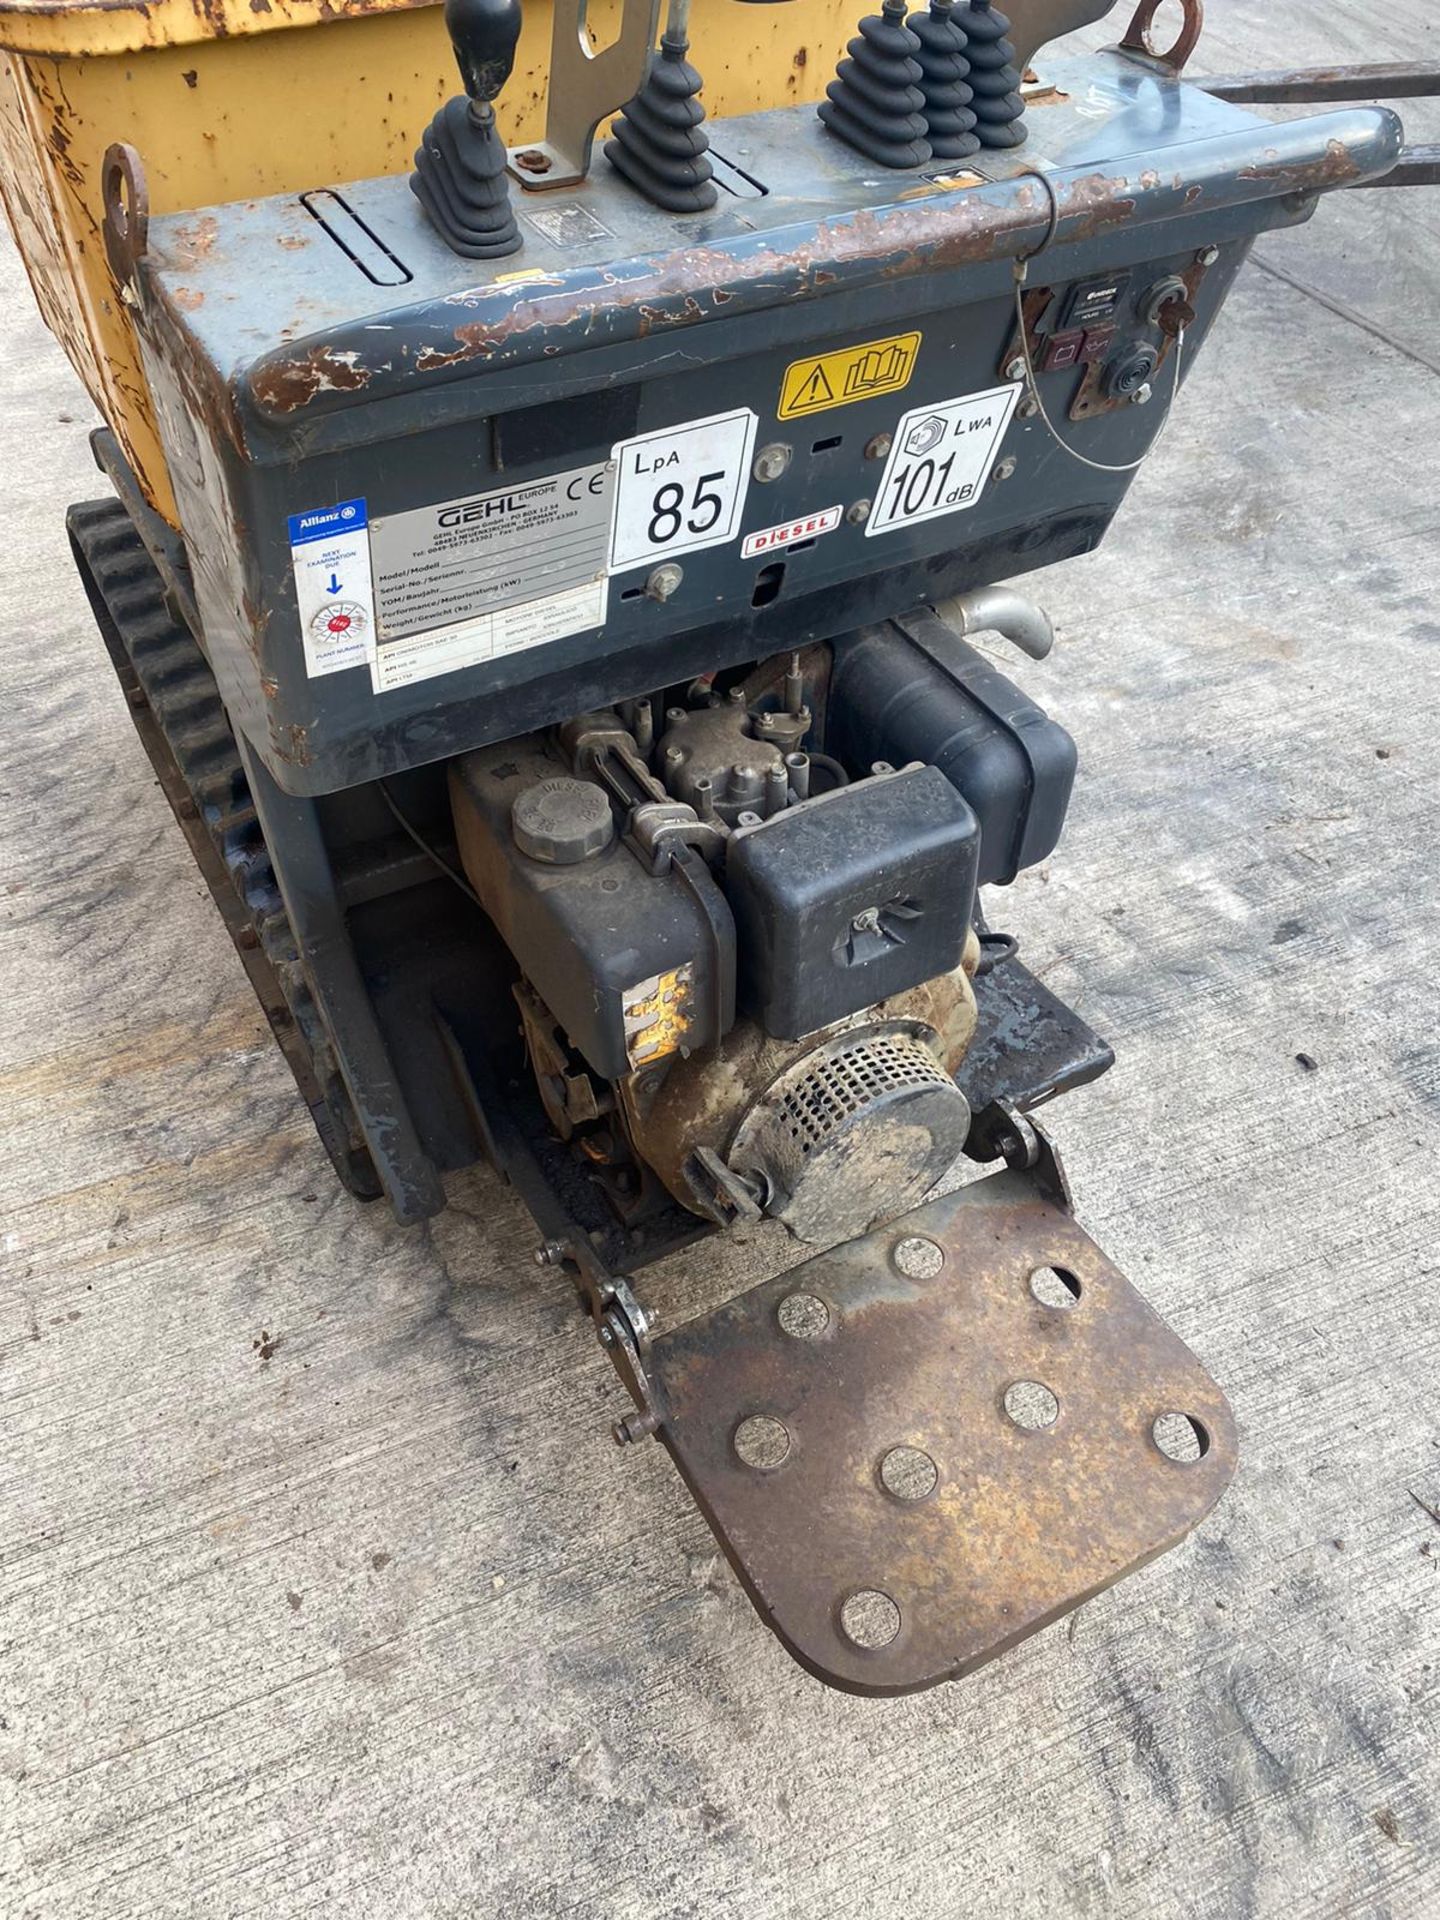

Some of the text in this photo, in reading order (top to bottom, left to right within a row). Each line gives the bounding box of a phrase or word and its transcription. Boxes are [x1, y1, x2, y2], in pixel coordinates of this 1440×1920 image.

[635, 451, 680, 474] LpA
[888, 451, 973, 520] 101 dB
[437, 486, 557, 528] GEHL EUROPE
[647, 470, 726, 544] 85
[300, 512, 340, 529] Allianz
[433, 531, 452, 540] GEHL
[454, 525, 481, 535] Europe
[481, 518, 505, 529] GmbH
[510, 513, 521, 521] PO
[522, 510, 537, 518] BOX
[458, 522, 517, 540] NEUENKIRCHEN
[522, 510, 558, 524] GERMANY
[306, 551, 357, 568] EXAMINATION
[322, 549, 340, 558] NEXT
[325, 561, 340, 569] DUE
[378, 562, 440, 582] Model/Modell
[381, 587, 440, 607] YOM/Baujahr
[382, 585, 499, 619] Performance/Motorleistung
[500, 578, 522, 589] (kW)
[383, 608, 452, 630] Weight/Gewicht
[454, 603, 473, 614] (kg)
[315, 643, 365, 660] PLANT NUMBER
